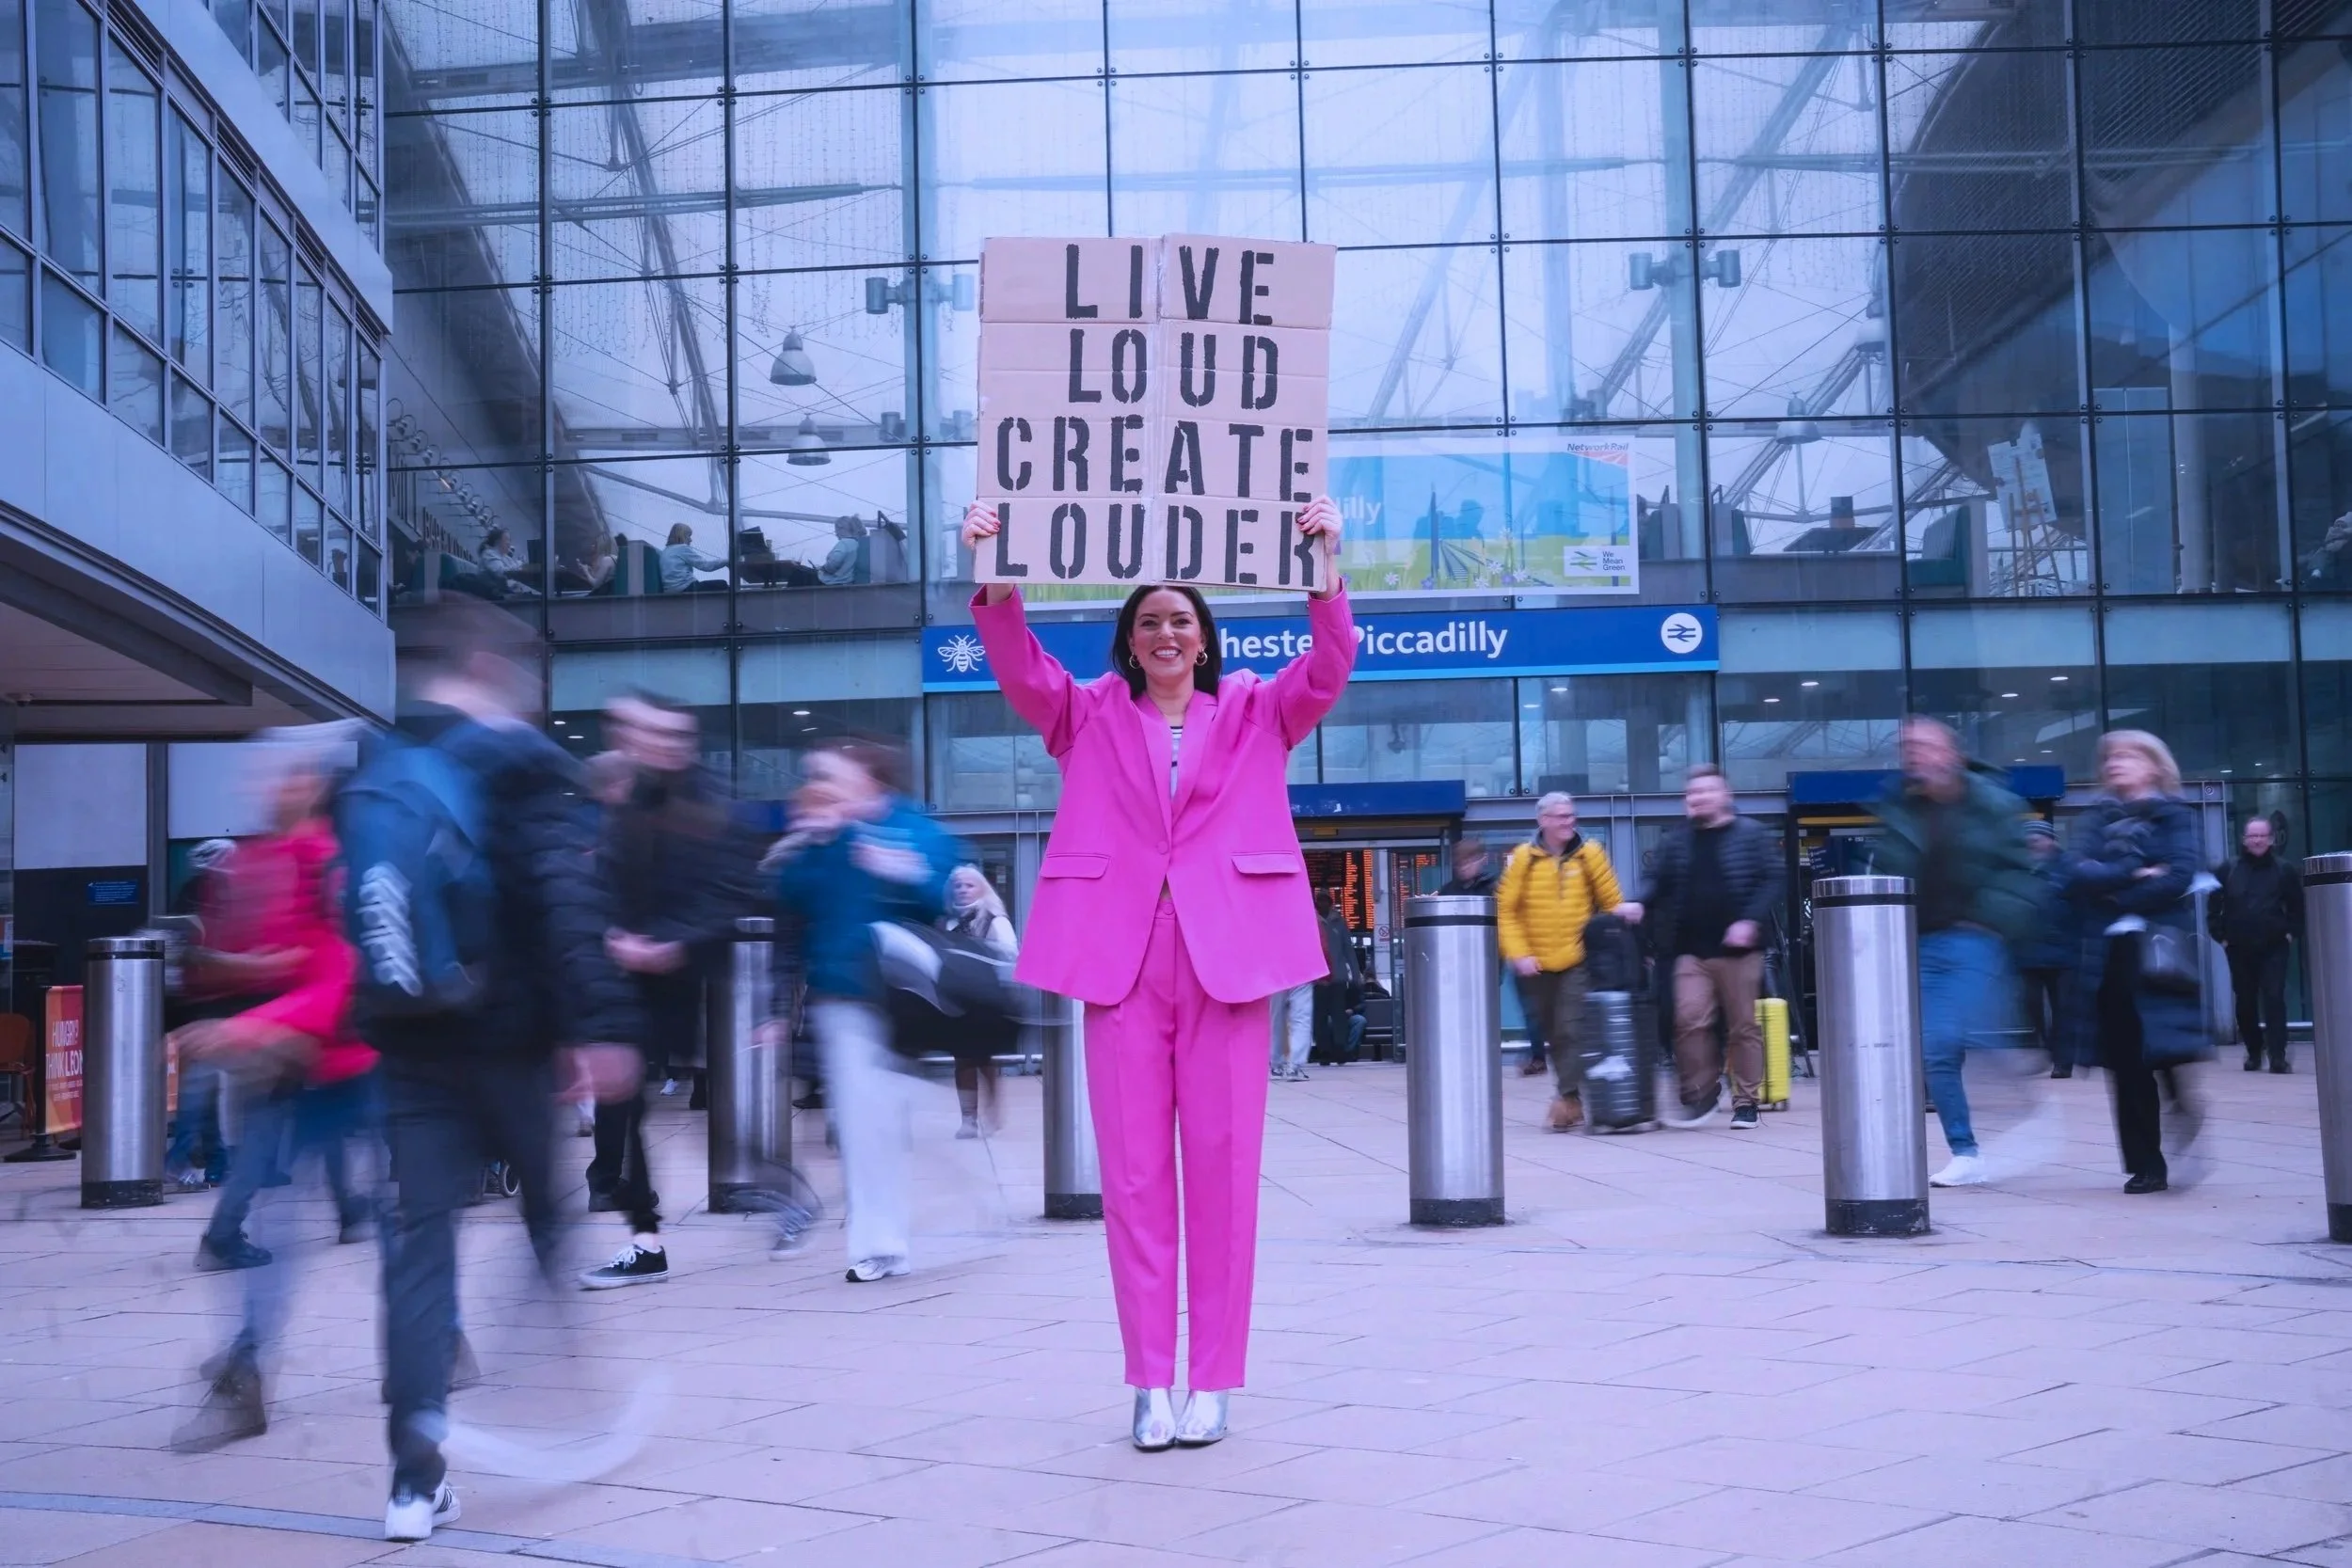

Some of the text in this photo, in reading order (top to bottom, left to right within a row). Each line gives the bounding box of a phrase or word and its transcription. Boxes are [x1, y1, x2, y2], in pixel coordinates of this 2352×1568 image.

[1065, 243, 1275, 325] LIVE
[1068, 327, 1279, 410] LOUD
[996, 414, 1313, 503] CREATE
[994, 501, 1315, 588] LOUDER
[1336, 495, 1382, 526] illy
[1220, 627, 1313, 658] heste
[45, 1052, 65, 1080] THINK
